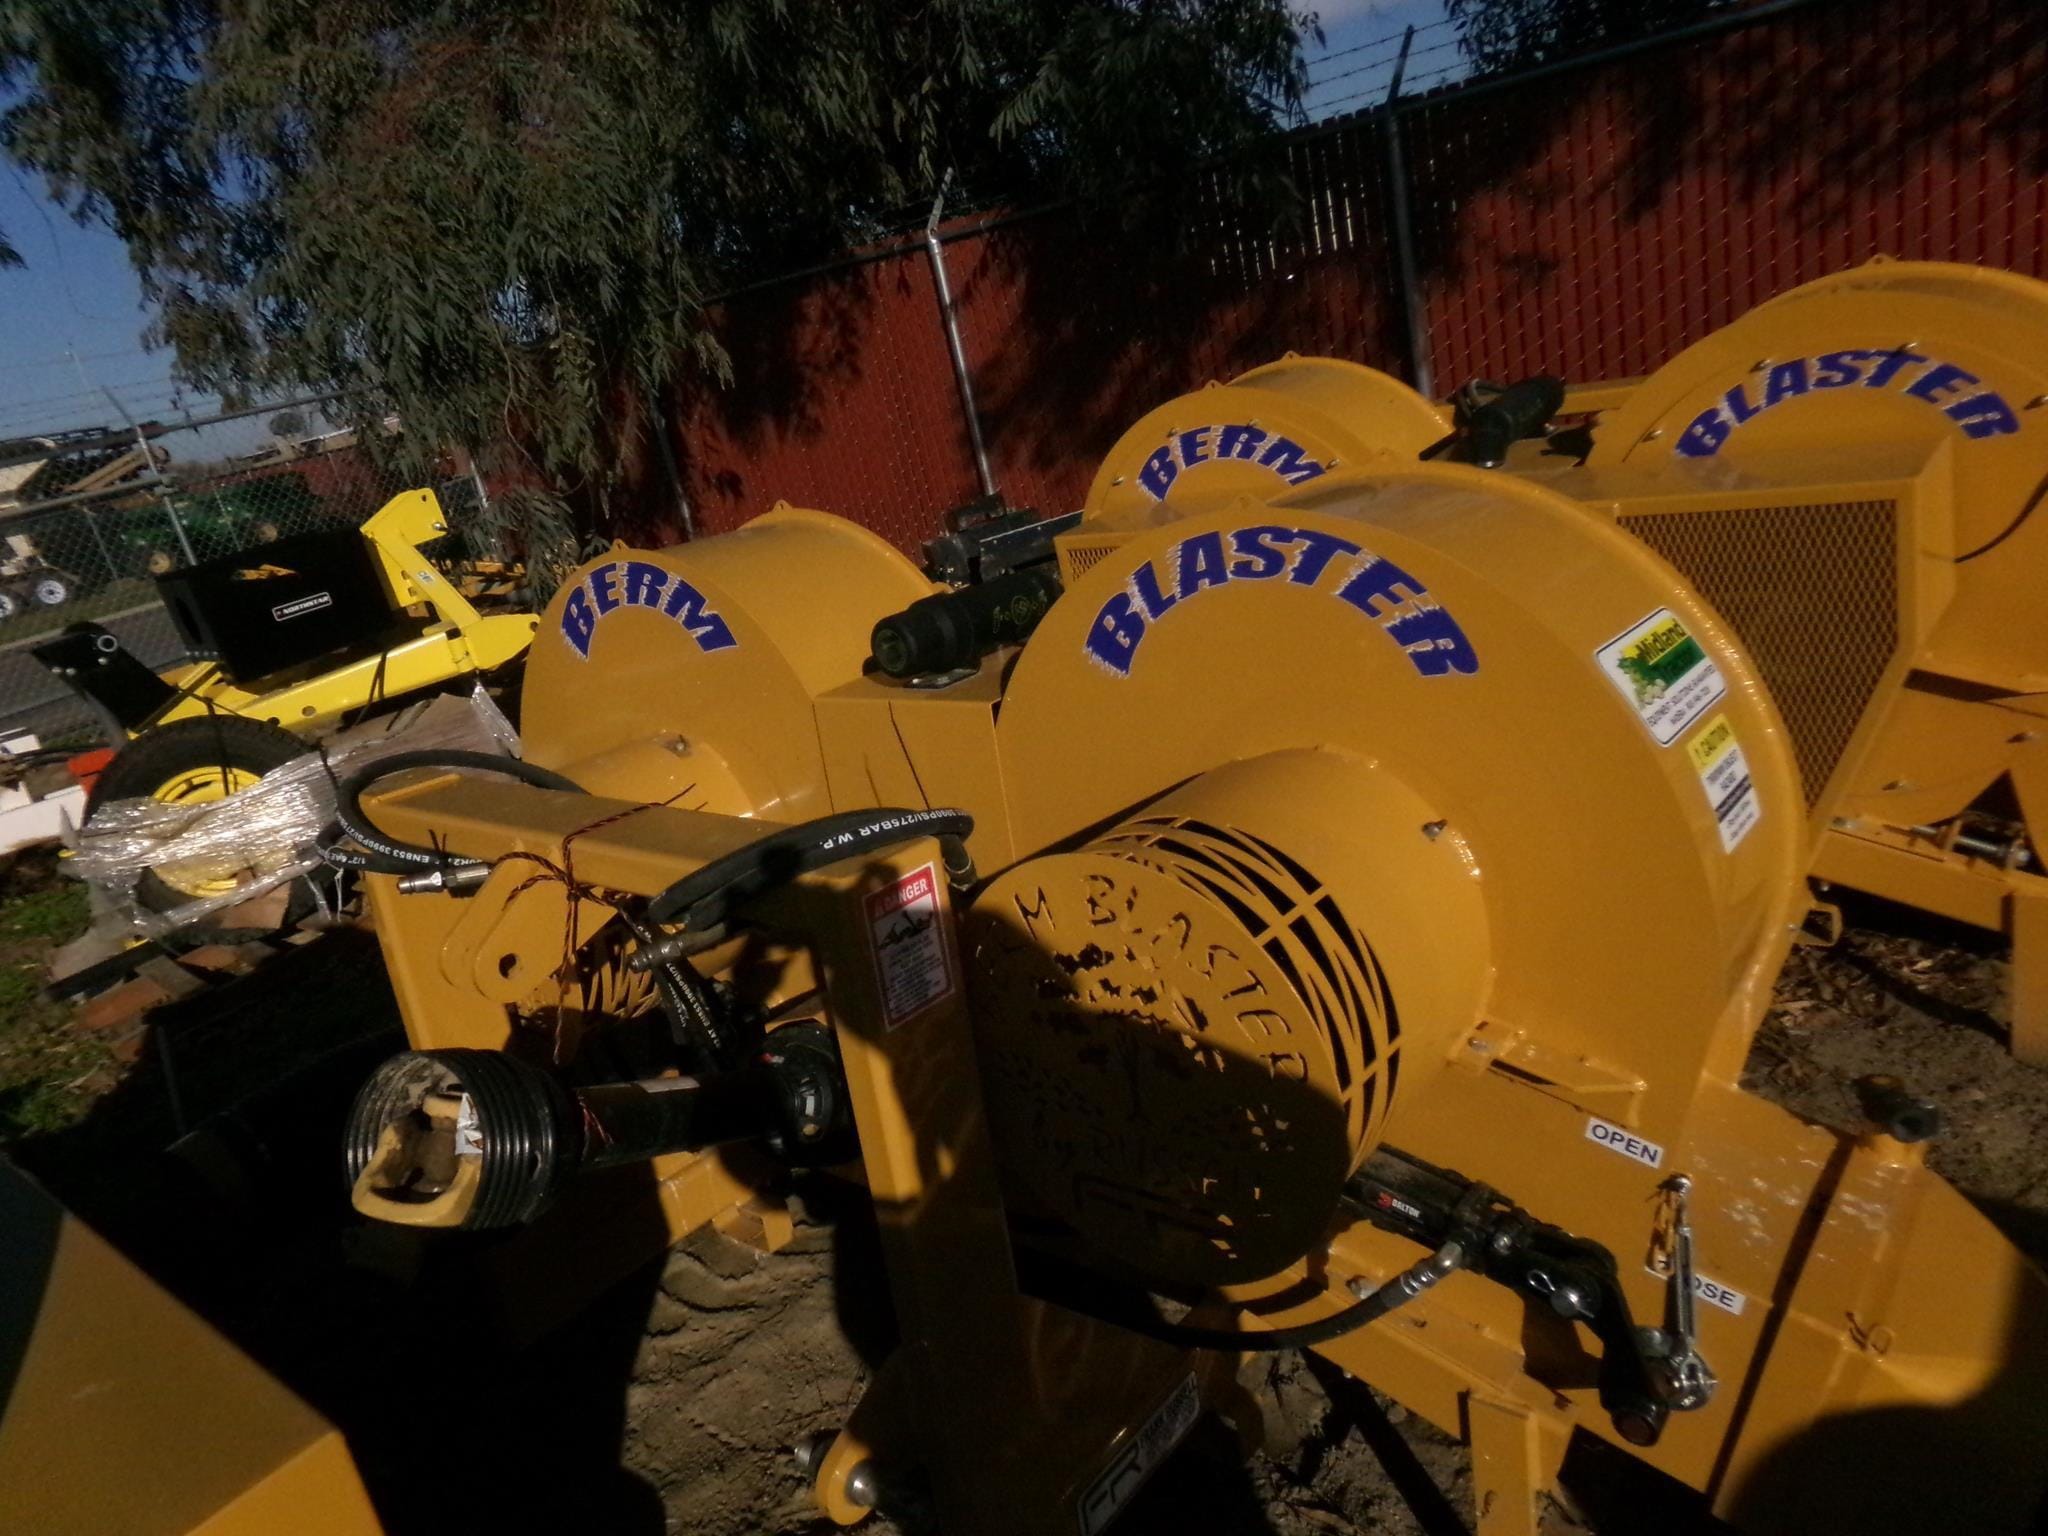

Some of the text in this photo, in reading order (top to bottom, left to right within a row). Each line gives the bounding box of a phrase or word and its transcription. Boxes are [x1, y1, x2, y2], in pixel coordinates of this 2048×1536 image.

[1676, 349, 2019, 457] BLASTER
[1137, 424, 1326, 501] BERM
[561, 560, 740, 663] BERM
[1082, 525, 1480, 678] BLASTER
[1638, 618, 1687, 660] Midland
[819, 832, 854, 850] W.P.
[881, 878, 928, 911] DANGER
[1591, 1123, 1659, 1164] OPEN
